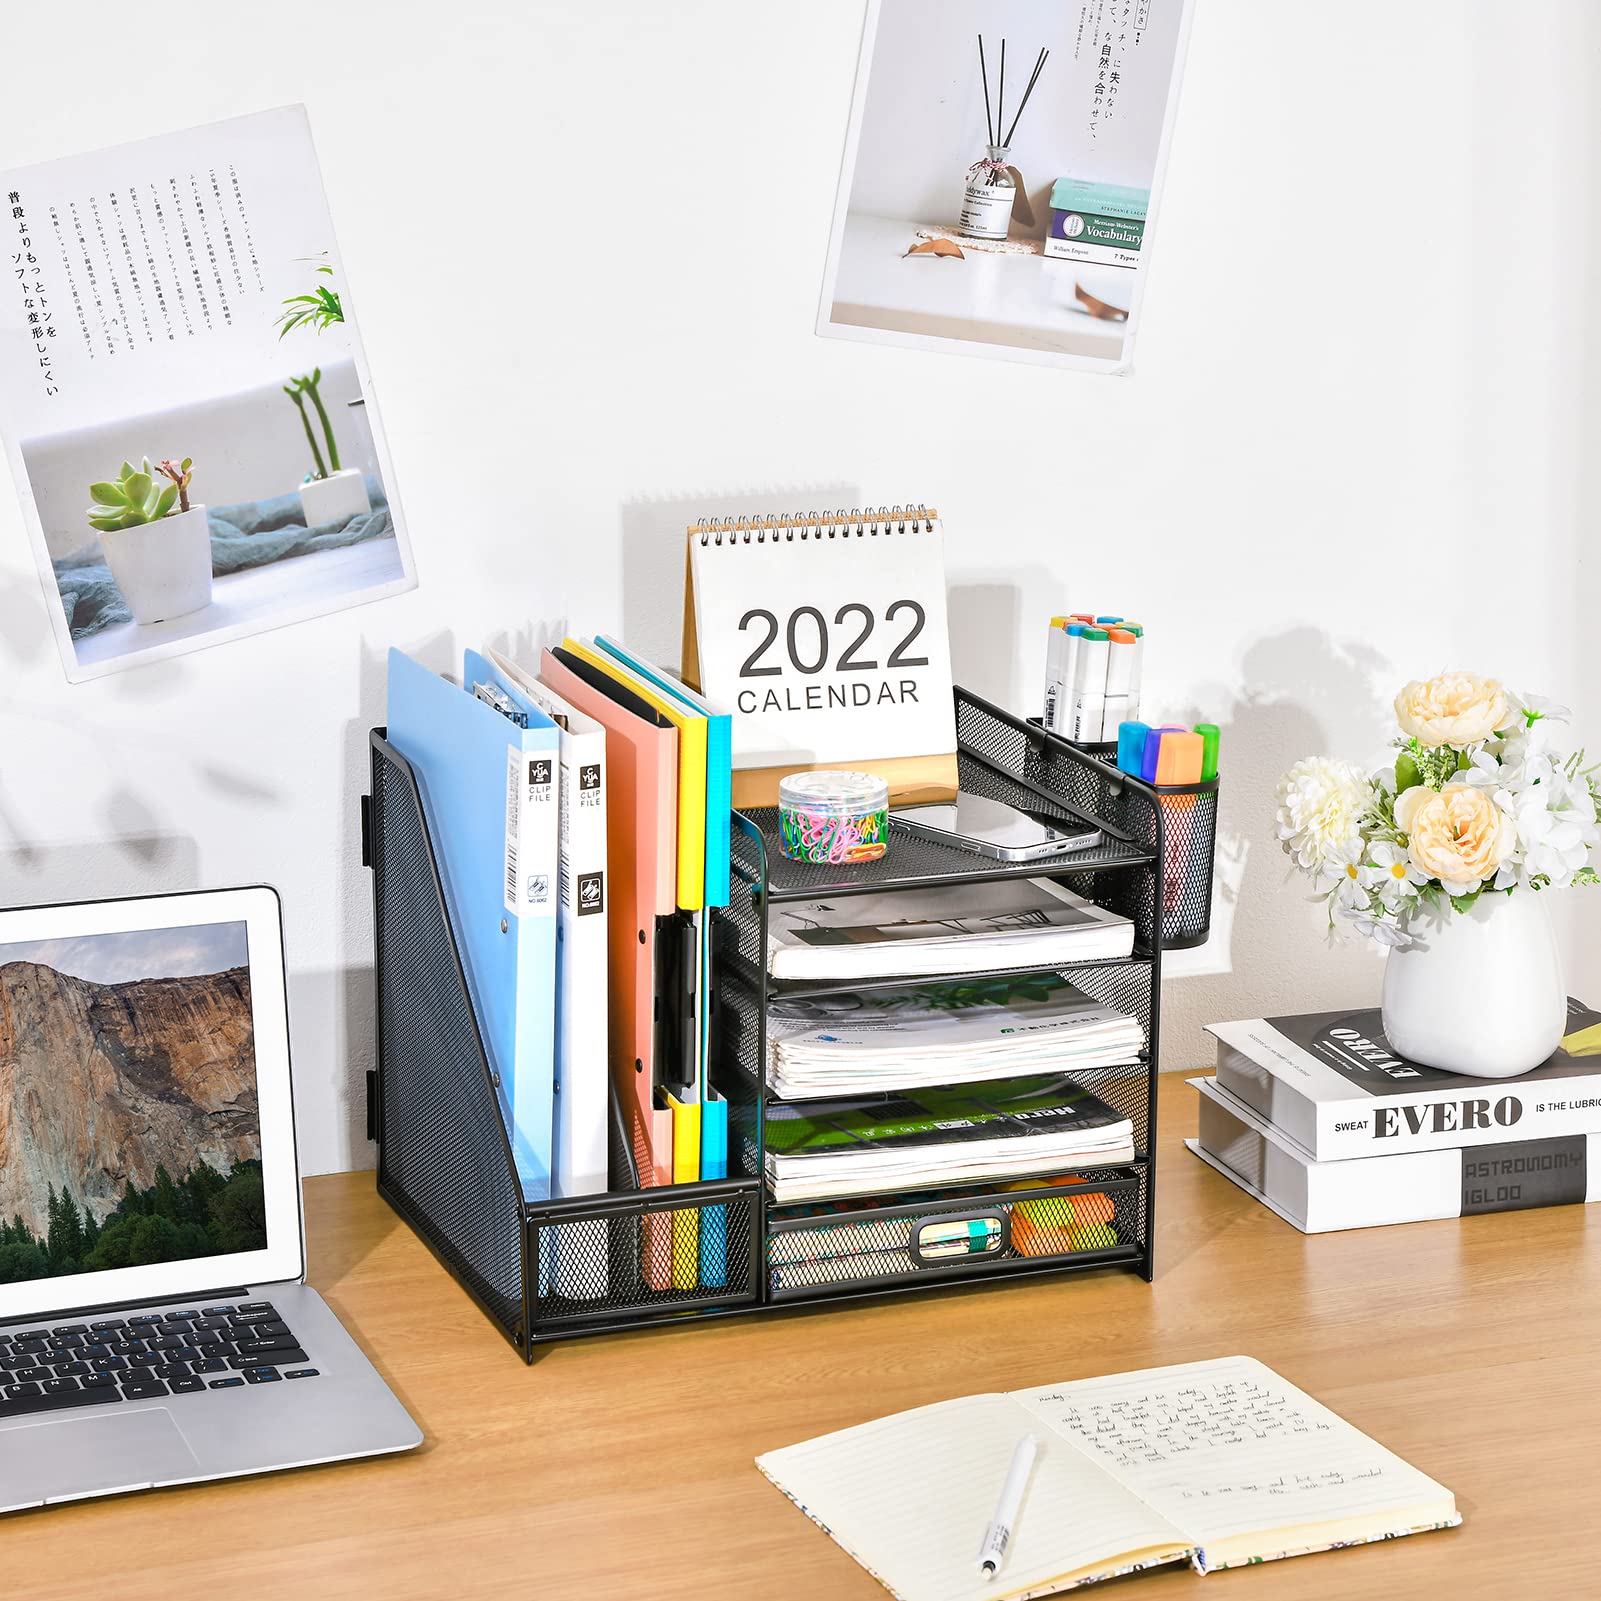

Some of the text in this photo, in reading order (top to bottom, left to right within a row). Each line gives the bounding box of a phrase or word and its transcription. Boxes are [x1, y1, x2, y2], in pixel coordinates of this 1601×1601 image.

[1089, 0, 1118, 138] て、な自然を合わせて、
[1087, 225, 1143, 246] Vocabulary
[8, 190, 57, 338] 普段よりもっとトンを
[11, 252, 59, 396] ソフトな変形しにくい
[738, 600, 929, 678] 2022
[737, 679, 919, 714] CALENDAR
[529, 786, 551, 794] CLIP
[529, 794, 551, 802] FILE
[580, 789, 600, 799] CLIP
[580, 798, 600, 807] FILE
[1329, 1028, 1424, 1079] EVERO
[1334, 1120, 1369, 1133] SWEAT
[1371, 1095, 1524, 1139] EVERO
[1536, 1104, 1545, 1112] IS
[1548, 1101, 1566, 1111] THE
[1465, 1152, 1583, 1179] ASTRONOMY
[1465, 1184, 1522, 1206] IGLOO
